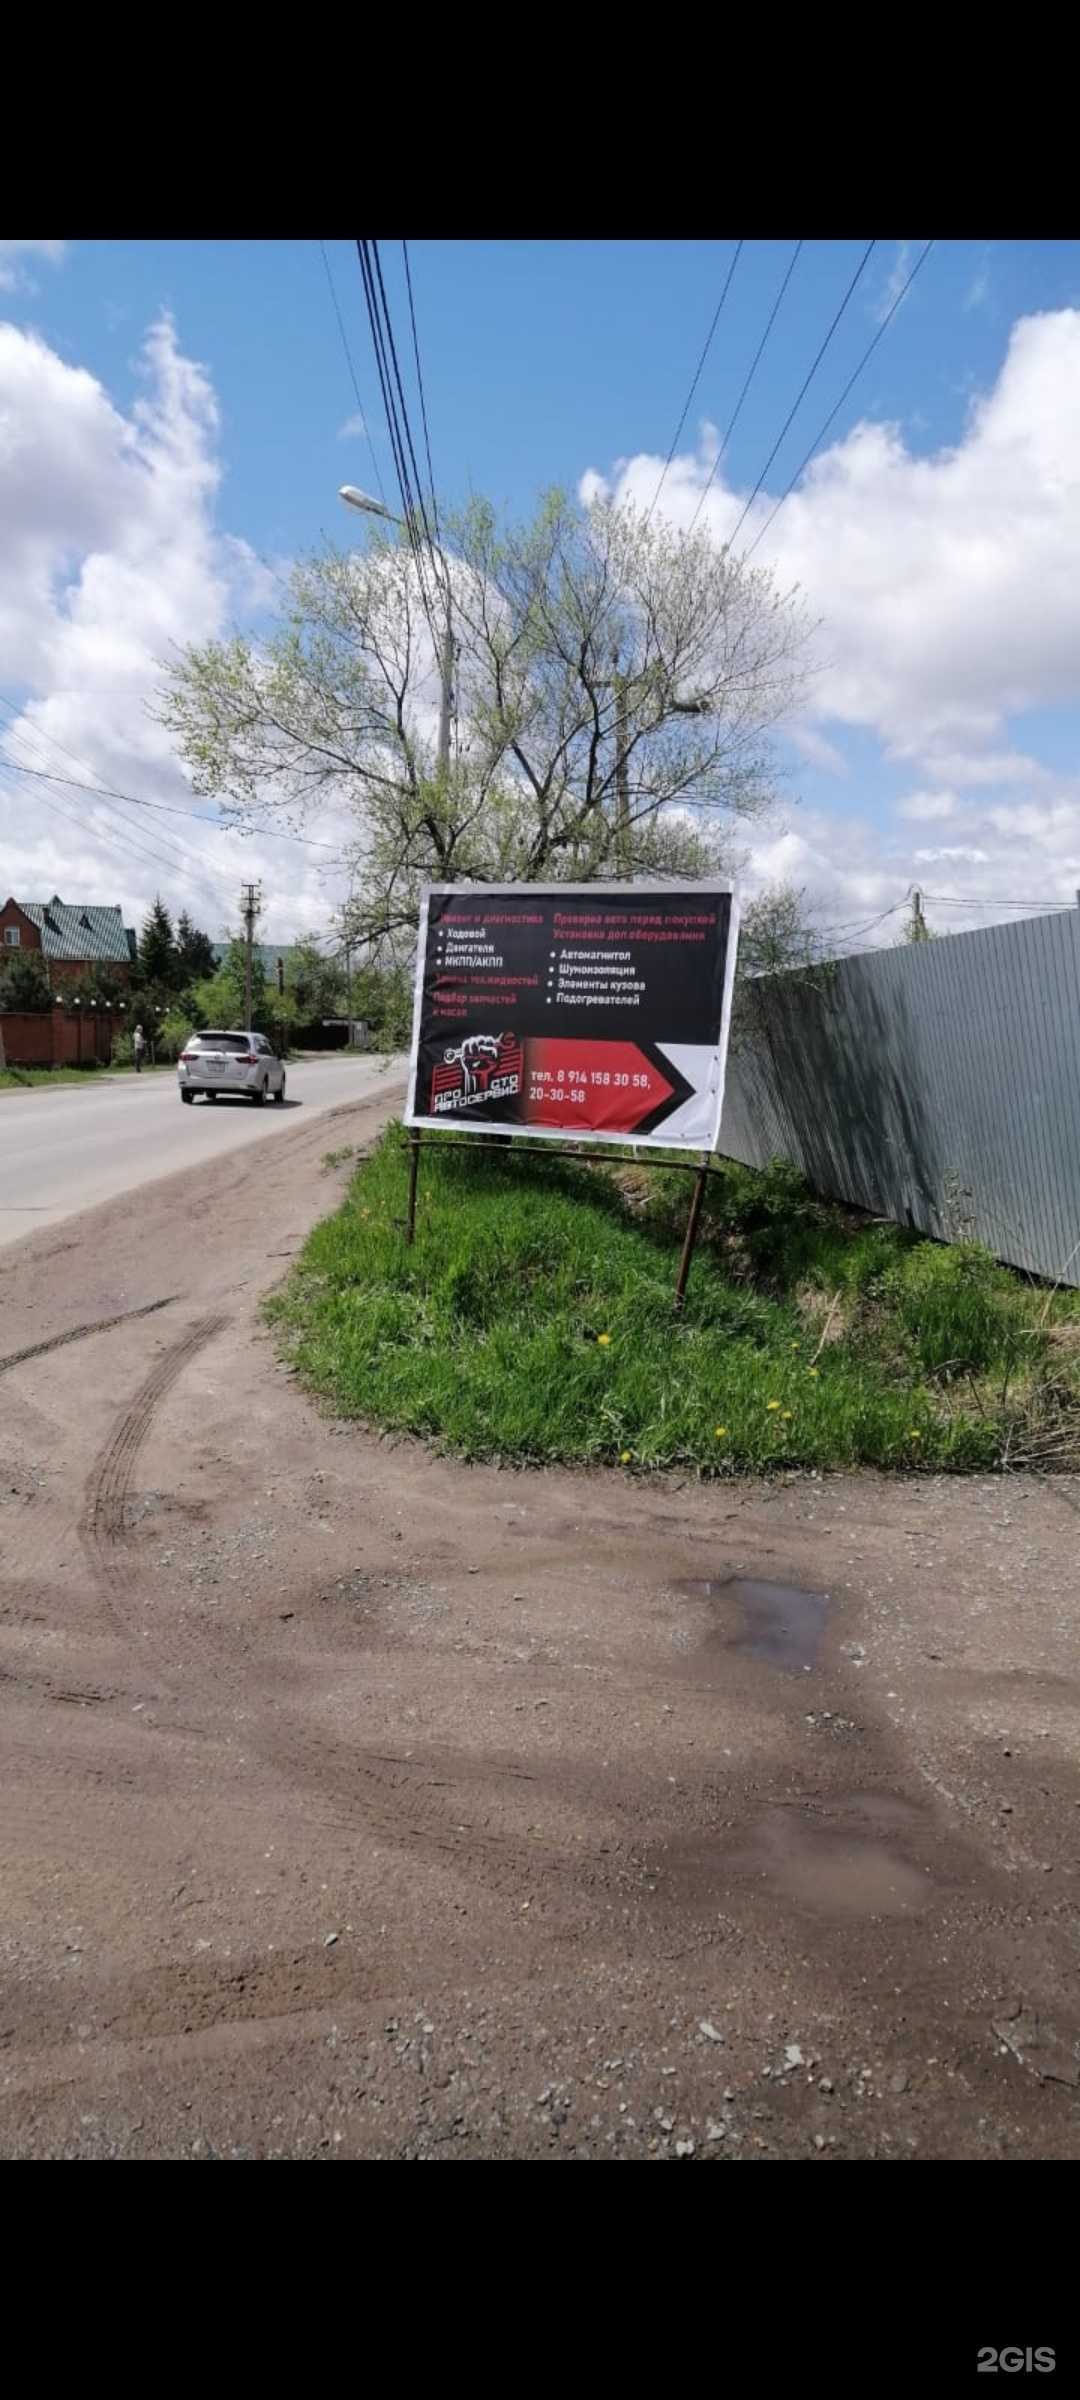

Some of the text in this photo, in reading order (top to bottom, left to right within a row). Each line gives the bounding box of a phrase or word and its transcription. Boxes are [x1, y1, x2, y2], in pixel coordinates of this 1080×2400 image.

[553, 913, 601, 926] Проверка
[604, 915, 627, 924] авто
[630, 915, 662, 926] перед
[446, 928, 486, 939] Ходовой
[553, 929, 605, 939] Установка
[445, 943, 495, 953] Двигателя
[560, 949, 631, 961] Автомагнитол
[445, 956, 503, 968] МКПП/АКПП
[559, 963, 636, 976] Шумоизоляция
[558, 978, 646, 992] Элементы кузова
[433, 992, 467, 1004] Подбор
[556, 992, 640, 1006] Подогревателей
[531, 1070, 651, 1090] тел. 8 914 158 30 58,
[434, 1074, 518, 1104] ПРО СТО
[529, 1087, 585, 1102] 20-30-58
[434, 1084, 519, 1113] АВТОСЕРВИС
